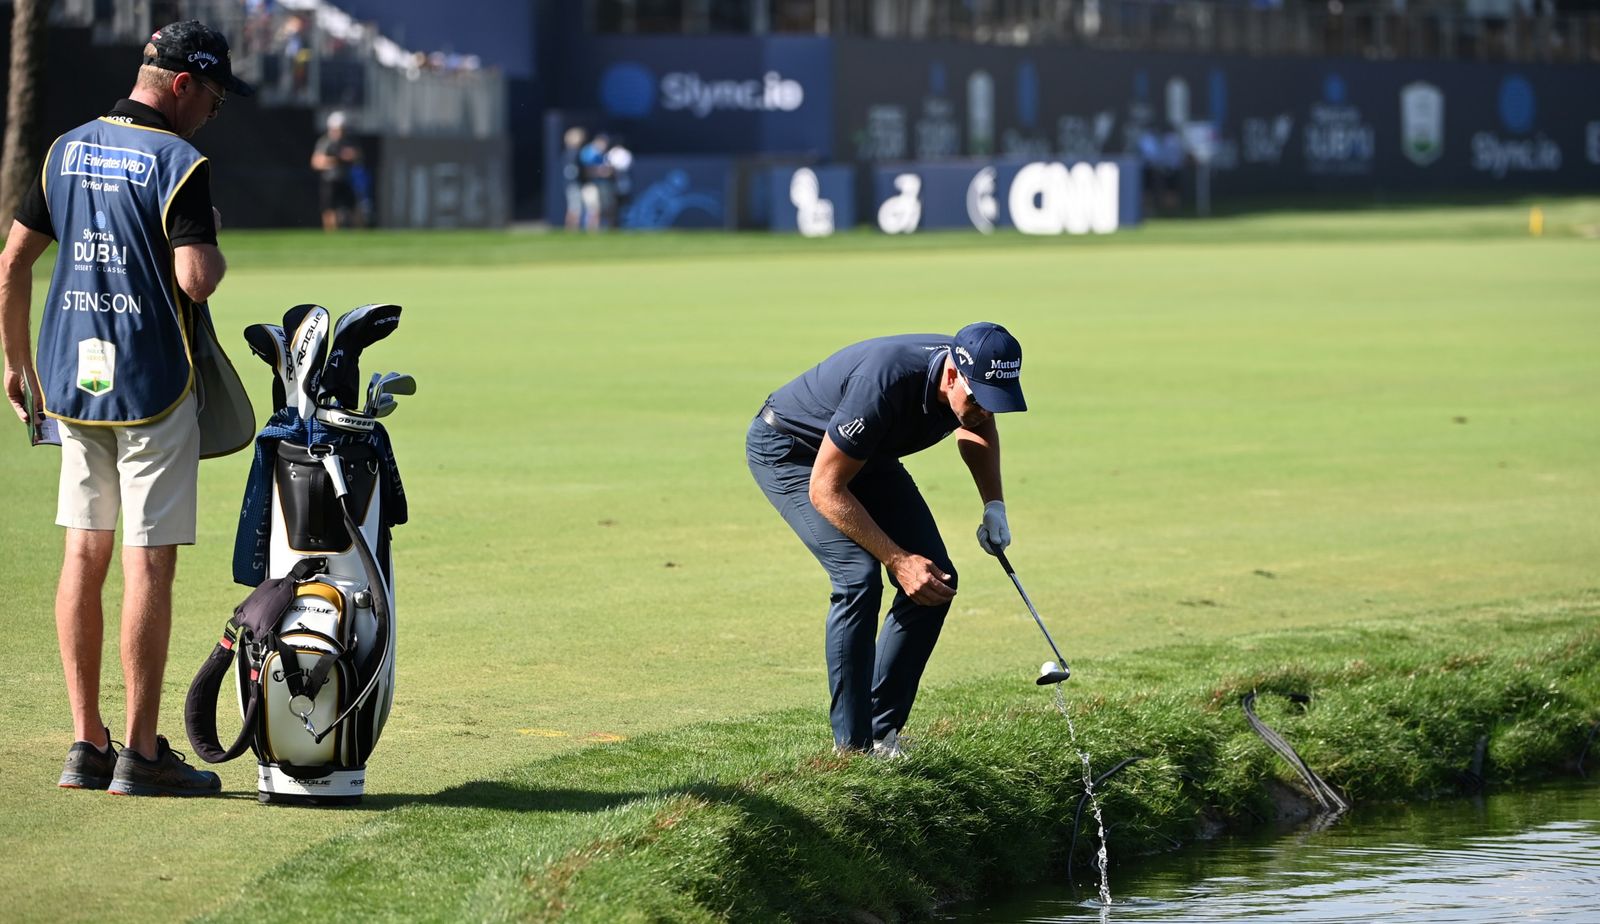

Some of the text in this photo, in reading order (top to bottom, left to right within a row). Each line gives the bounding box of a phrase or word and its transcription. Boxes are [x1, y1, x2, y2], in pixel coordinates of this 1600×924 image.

[187, 50, 219, 65] Callaway
[661, 71, 803, 117] Slync.io
[121, 157, 146, 174] NBD
[103, 182, 120, 193] Bank
[1008, 161, 1119, 234] CNN
[74, 241, 127, 265] DUBAI
[62, 290, 142, 314] STENSON
[297, 312, 324, 367] ROGUE
[991, 357, 1020, 370] Mutual
[984, 369, 1020, 380] of Omah
